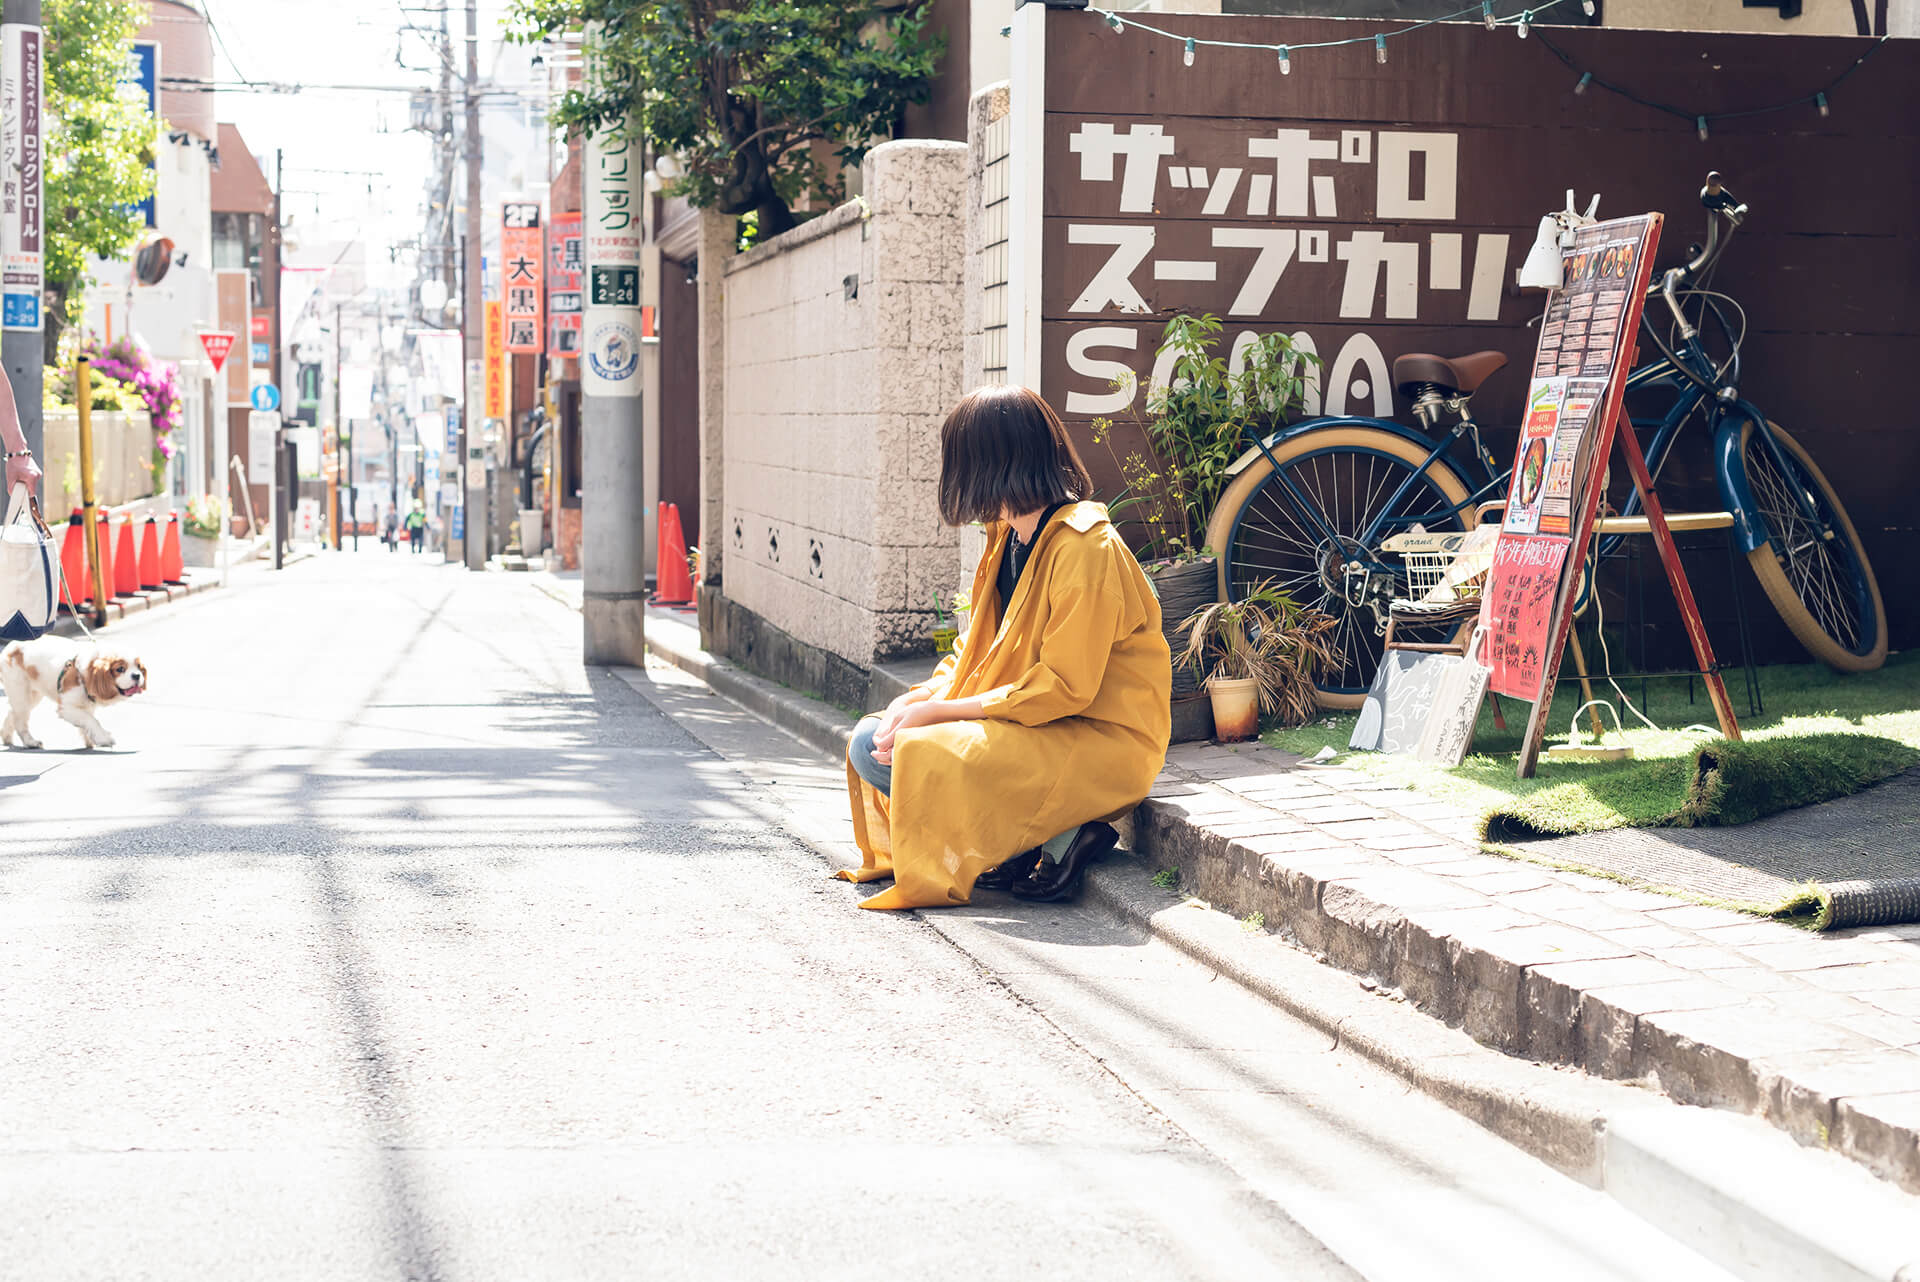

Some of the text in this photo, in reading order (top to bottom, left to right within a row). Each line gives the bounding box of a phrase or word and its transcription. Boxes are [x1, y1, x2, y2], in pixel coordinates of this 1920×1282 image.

[1069, 122, 1459, 219] サッポロ
[505, 204, 538, 228] 2F
[509, 256, 535, 345] 大黒屋
[598, 272, 634, 286] 北沢
[1067, 224, 1523, 321] スープカリ
[1403, 537, 1434, 547] grand
